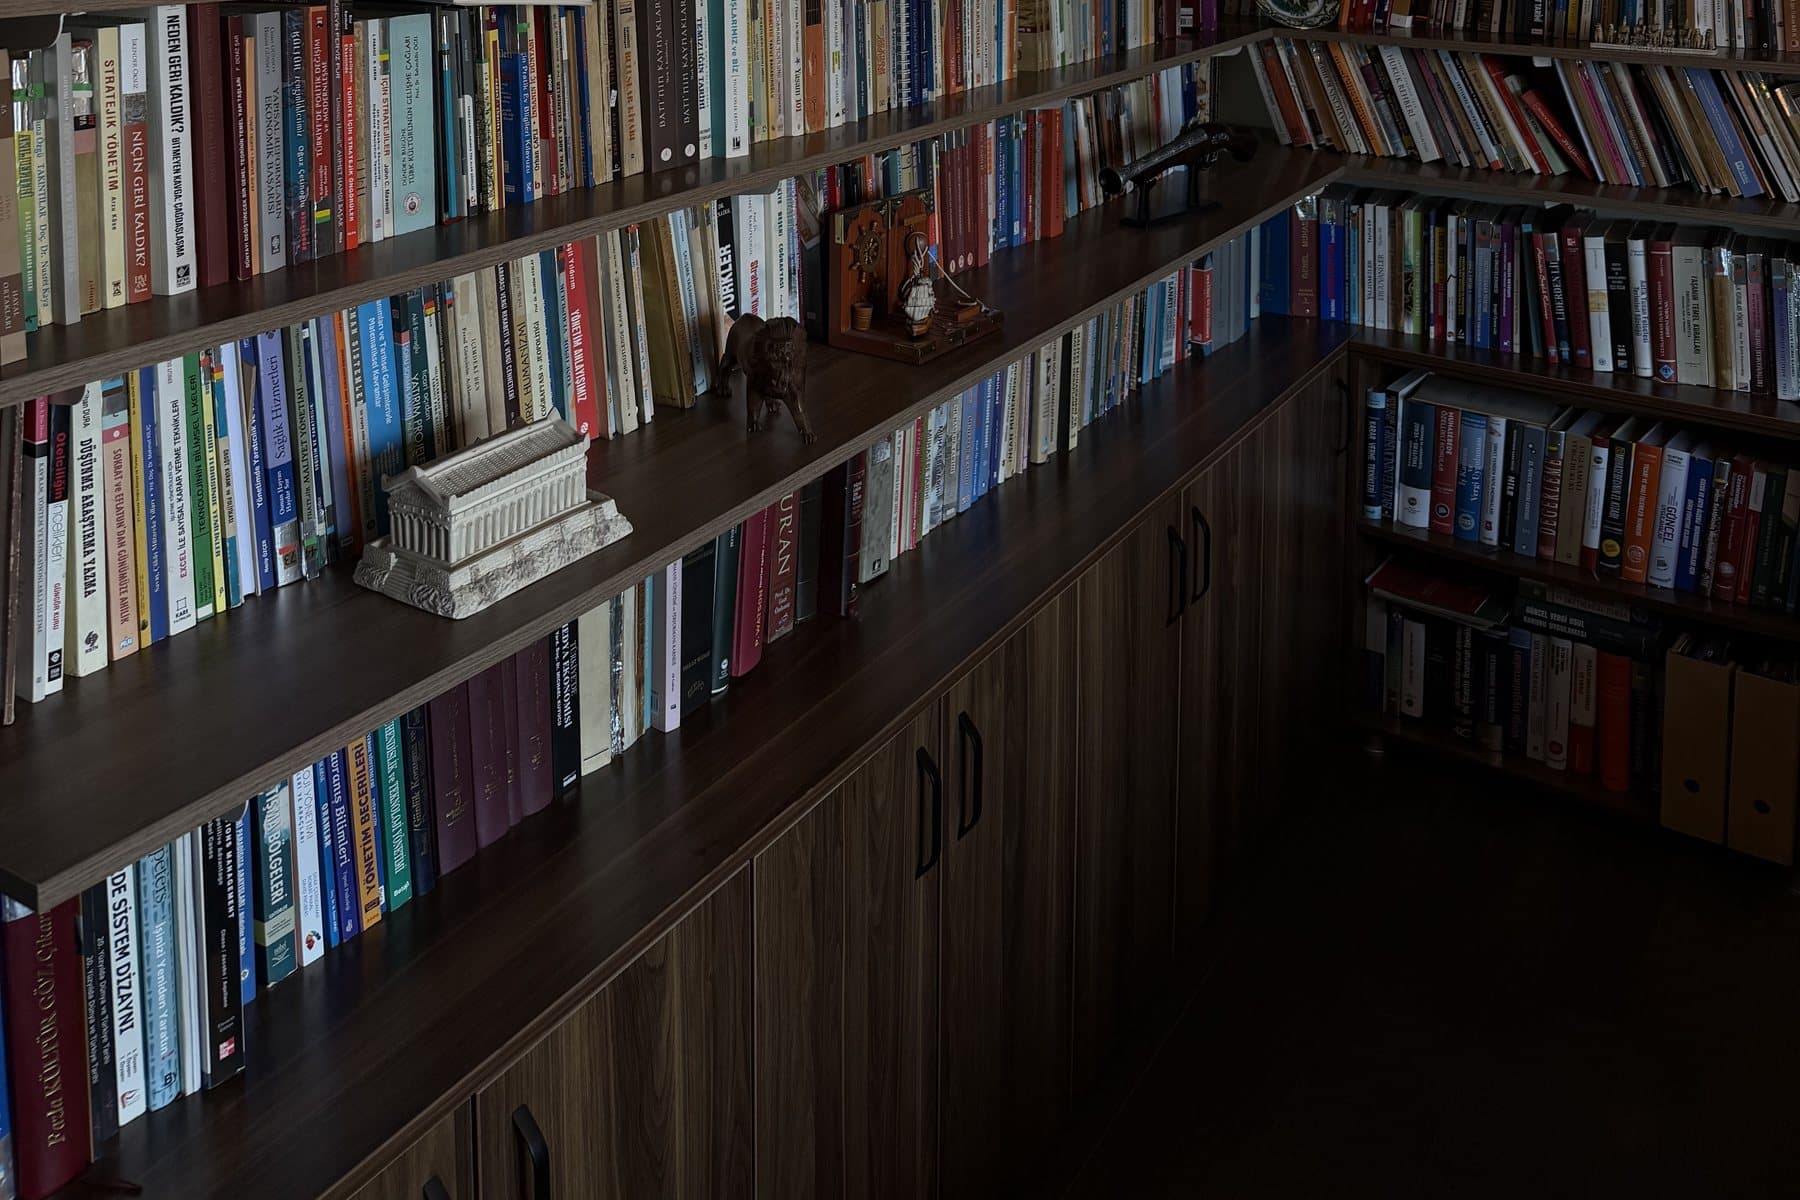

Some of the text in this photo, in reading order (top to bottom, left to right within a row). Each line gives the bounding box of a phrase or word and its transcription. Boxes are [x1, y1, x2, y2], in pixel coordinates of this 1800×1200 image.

[167, 14, 181, 54] NEDEN
[168, 55, 184, 82] GERİ
[104, 59, 119, 191] STRATEJİK YÖNETİM
[170, 84, 184, 133] KALDIK?
[382, 97, 391, 157] STRATEJİLER
[131, 130, 148, 267] NİÇİN GERİ KALDIK?
[11, 289, 20, 316] HAYAL
[41, 287, 50, 308] Kaya
[719, 244, 736, 315] TÜRKLER
[267, 355, 286, 459] Sağlık Hizmetleri
[113, 448, 124, 483] SOKRAT
[77, 438, 97, 598] DÜŞÜNME ARAŞTIRMA YAZMA
[776, 495, 794, 576] UR'AN
[179, 549, 188, 578] EXCEL
[562, 660, 574, 729] EKONOMİSİ
[320, 802, 332, 849] ORANLAR
[332, 804, 351, 867] Bilimleri
[352, 742, 377, 895] YÖNETİM BECERİLERİ
[224, 847, 236, 919] MANAGEMENT
[267, 831, 288, 905] BÖLGELERİ
[112, 903, 132, 958] SİSTEM
[115, 964, 136, 1035] DİZAYNI
[157, 958, 168, 1003] Yeniden
